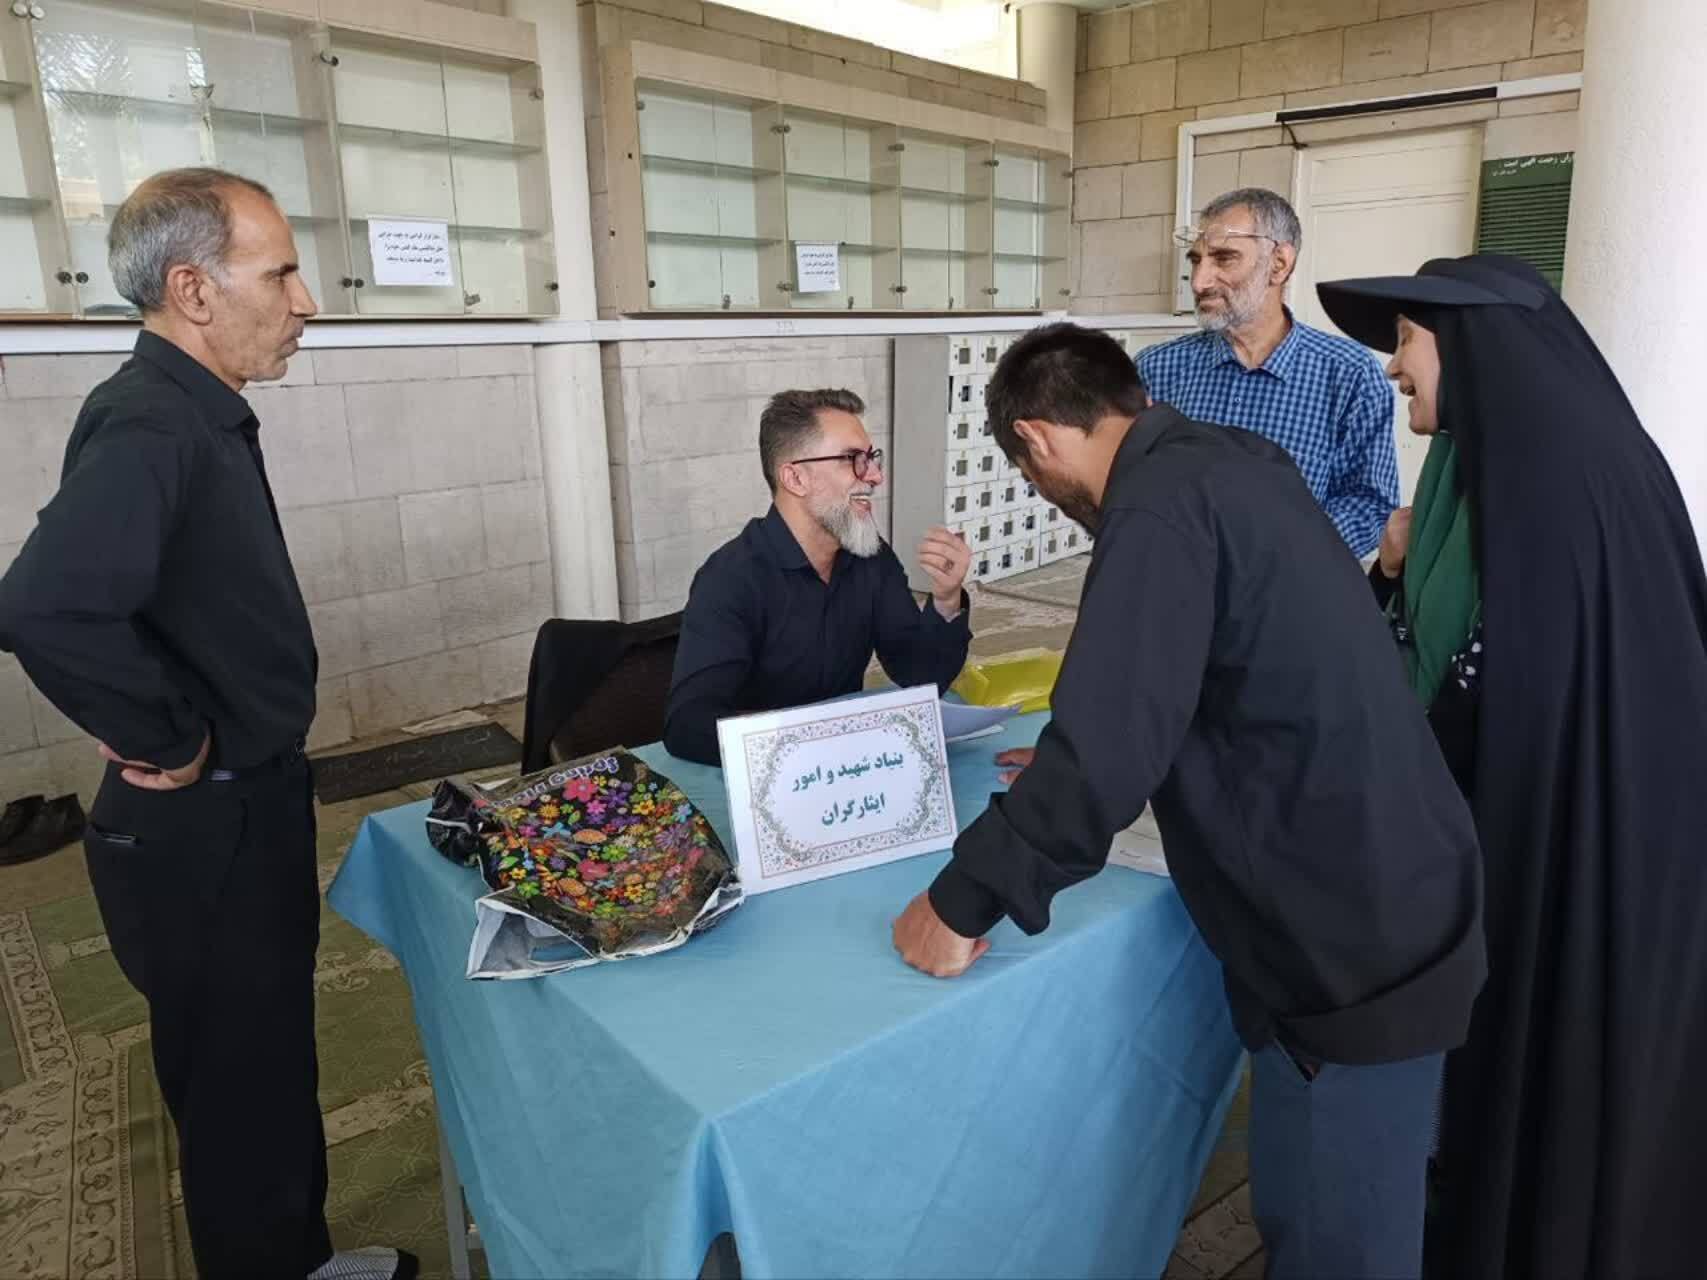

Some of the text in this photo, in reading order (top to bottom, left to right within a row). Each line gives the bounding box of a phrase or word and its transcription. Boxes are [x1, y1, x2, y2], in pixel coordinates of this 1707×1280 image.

[791, 752, 904, 792] بنیاد شهید و امور
[821, 791, 886, 826] ایثارگران
